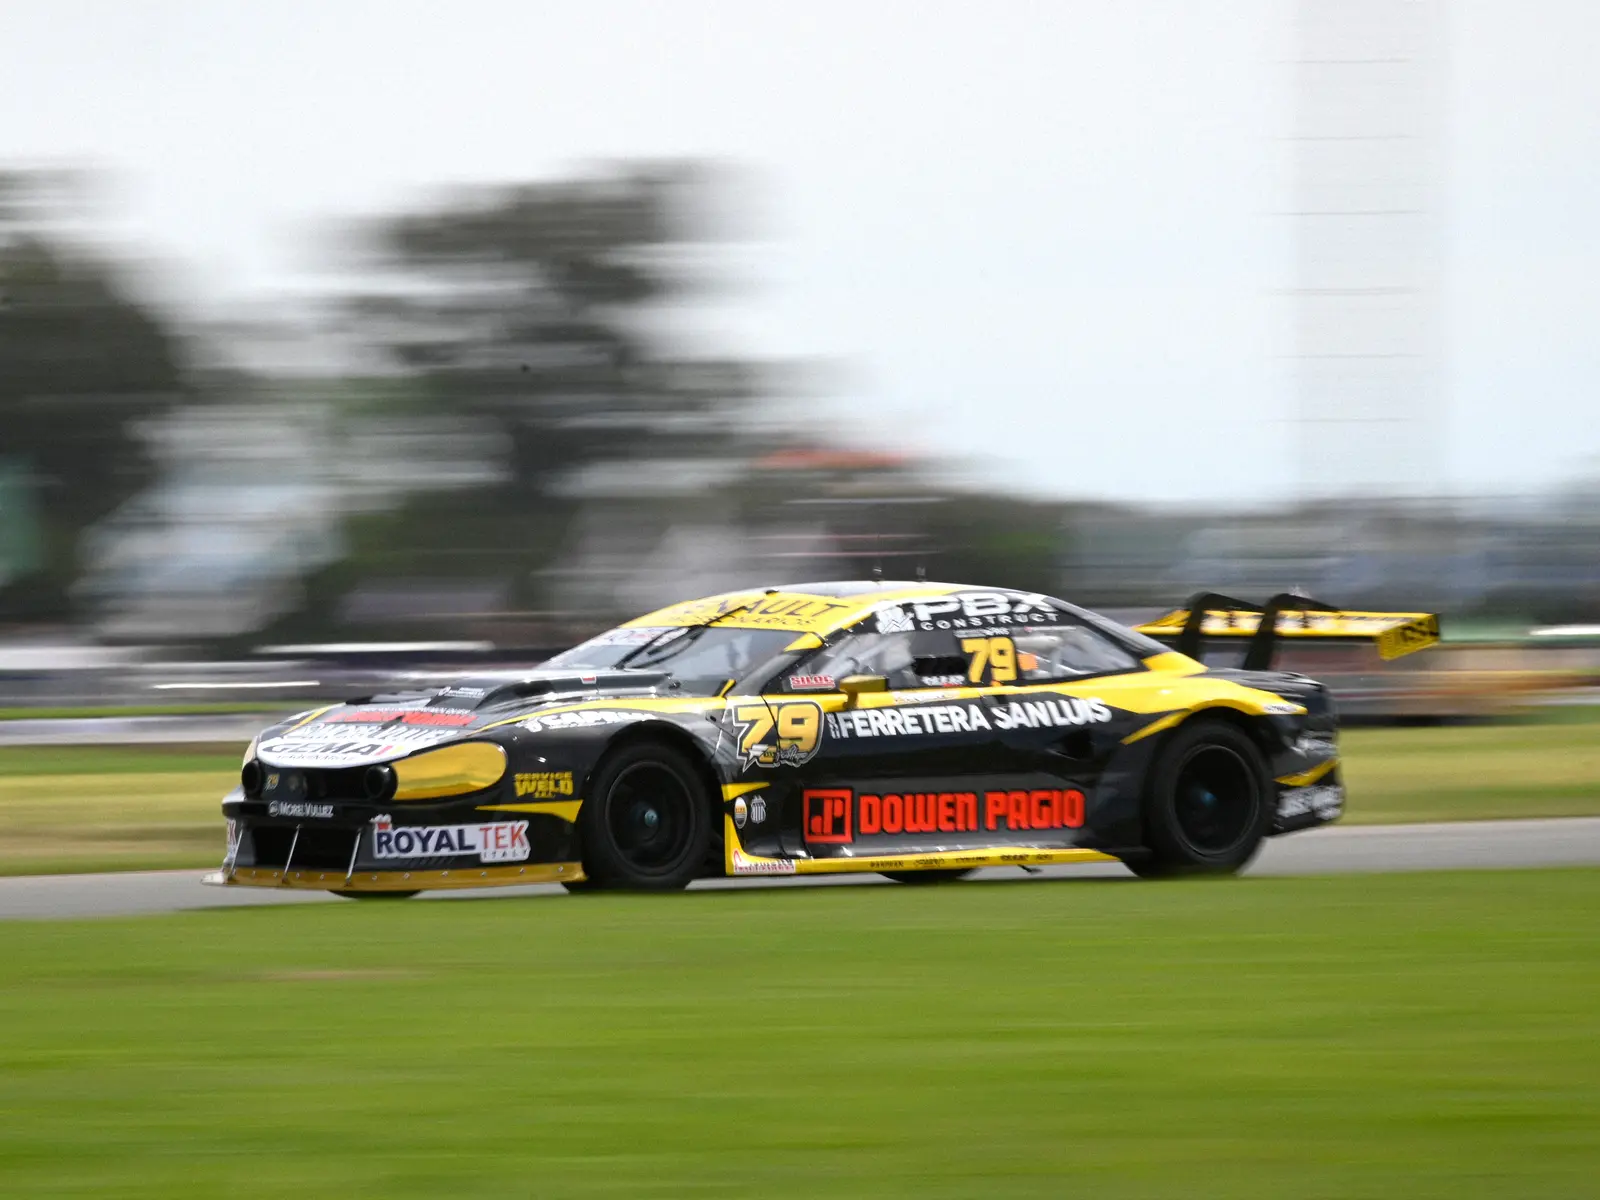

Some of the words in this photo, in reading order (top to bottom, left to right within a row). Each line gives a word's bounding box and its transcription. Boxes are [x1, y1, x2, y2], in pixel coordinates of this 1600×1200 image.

[914, 593, 1058, 621] PBX
[920, 612, 1059, 631] CONSTRUCT
[962, 637, 1018, 683] 79
[737, 704, 819, 754] 79
[841, 705, 992, 738] FERRETERA
[262, 742, 382, 755] GEMA
[514, 772, 572, 780] SERVICE
[514, 779, 573, 797] WELD
[859, 794, 979, 834] DOWEN
[984, 789, 1086, 831] PAGIO
[376, 829, 476, 854] ROYAL
[479, 823, 526, 850] TEK
[482, 849, 528, 859] ITALY
